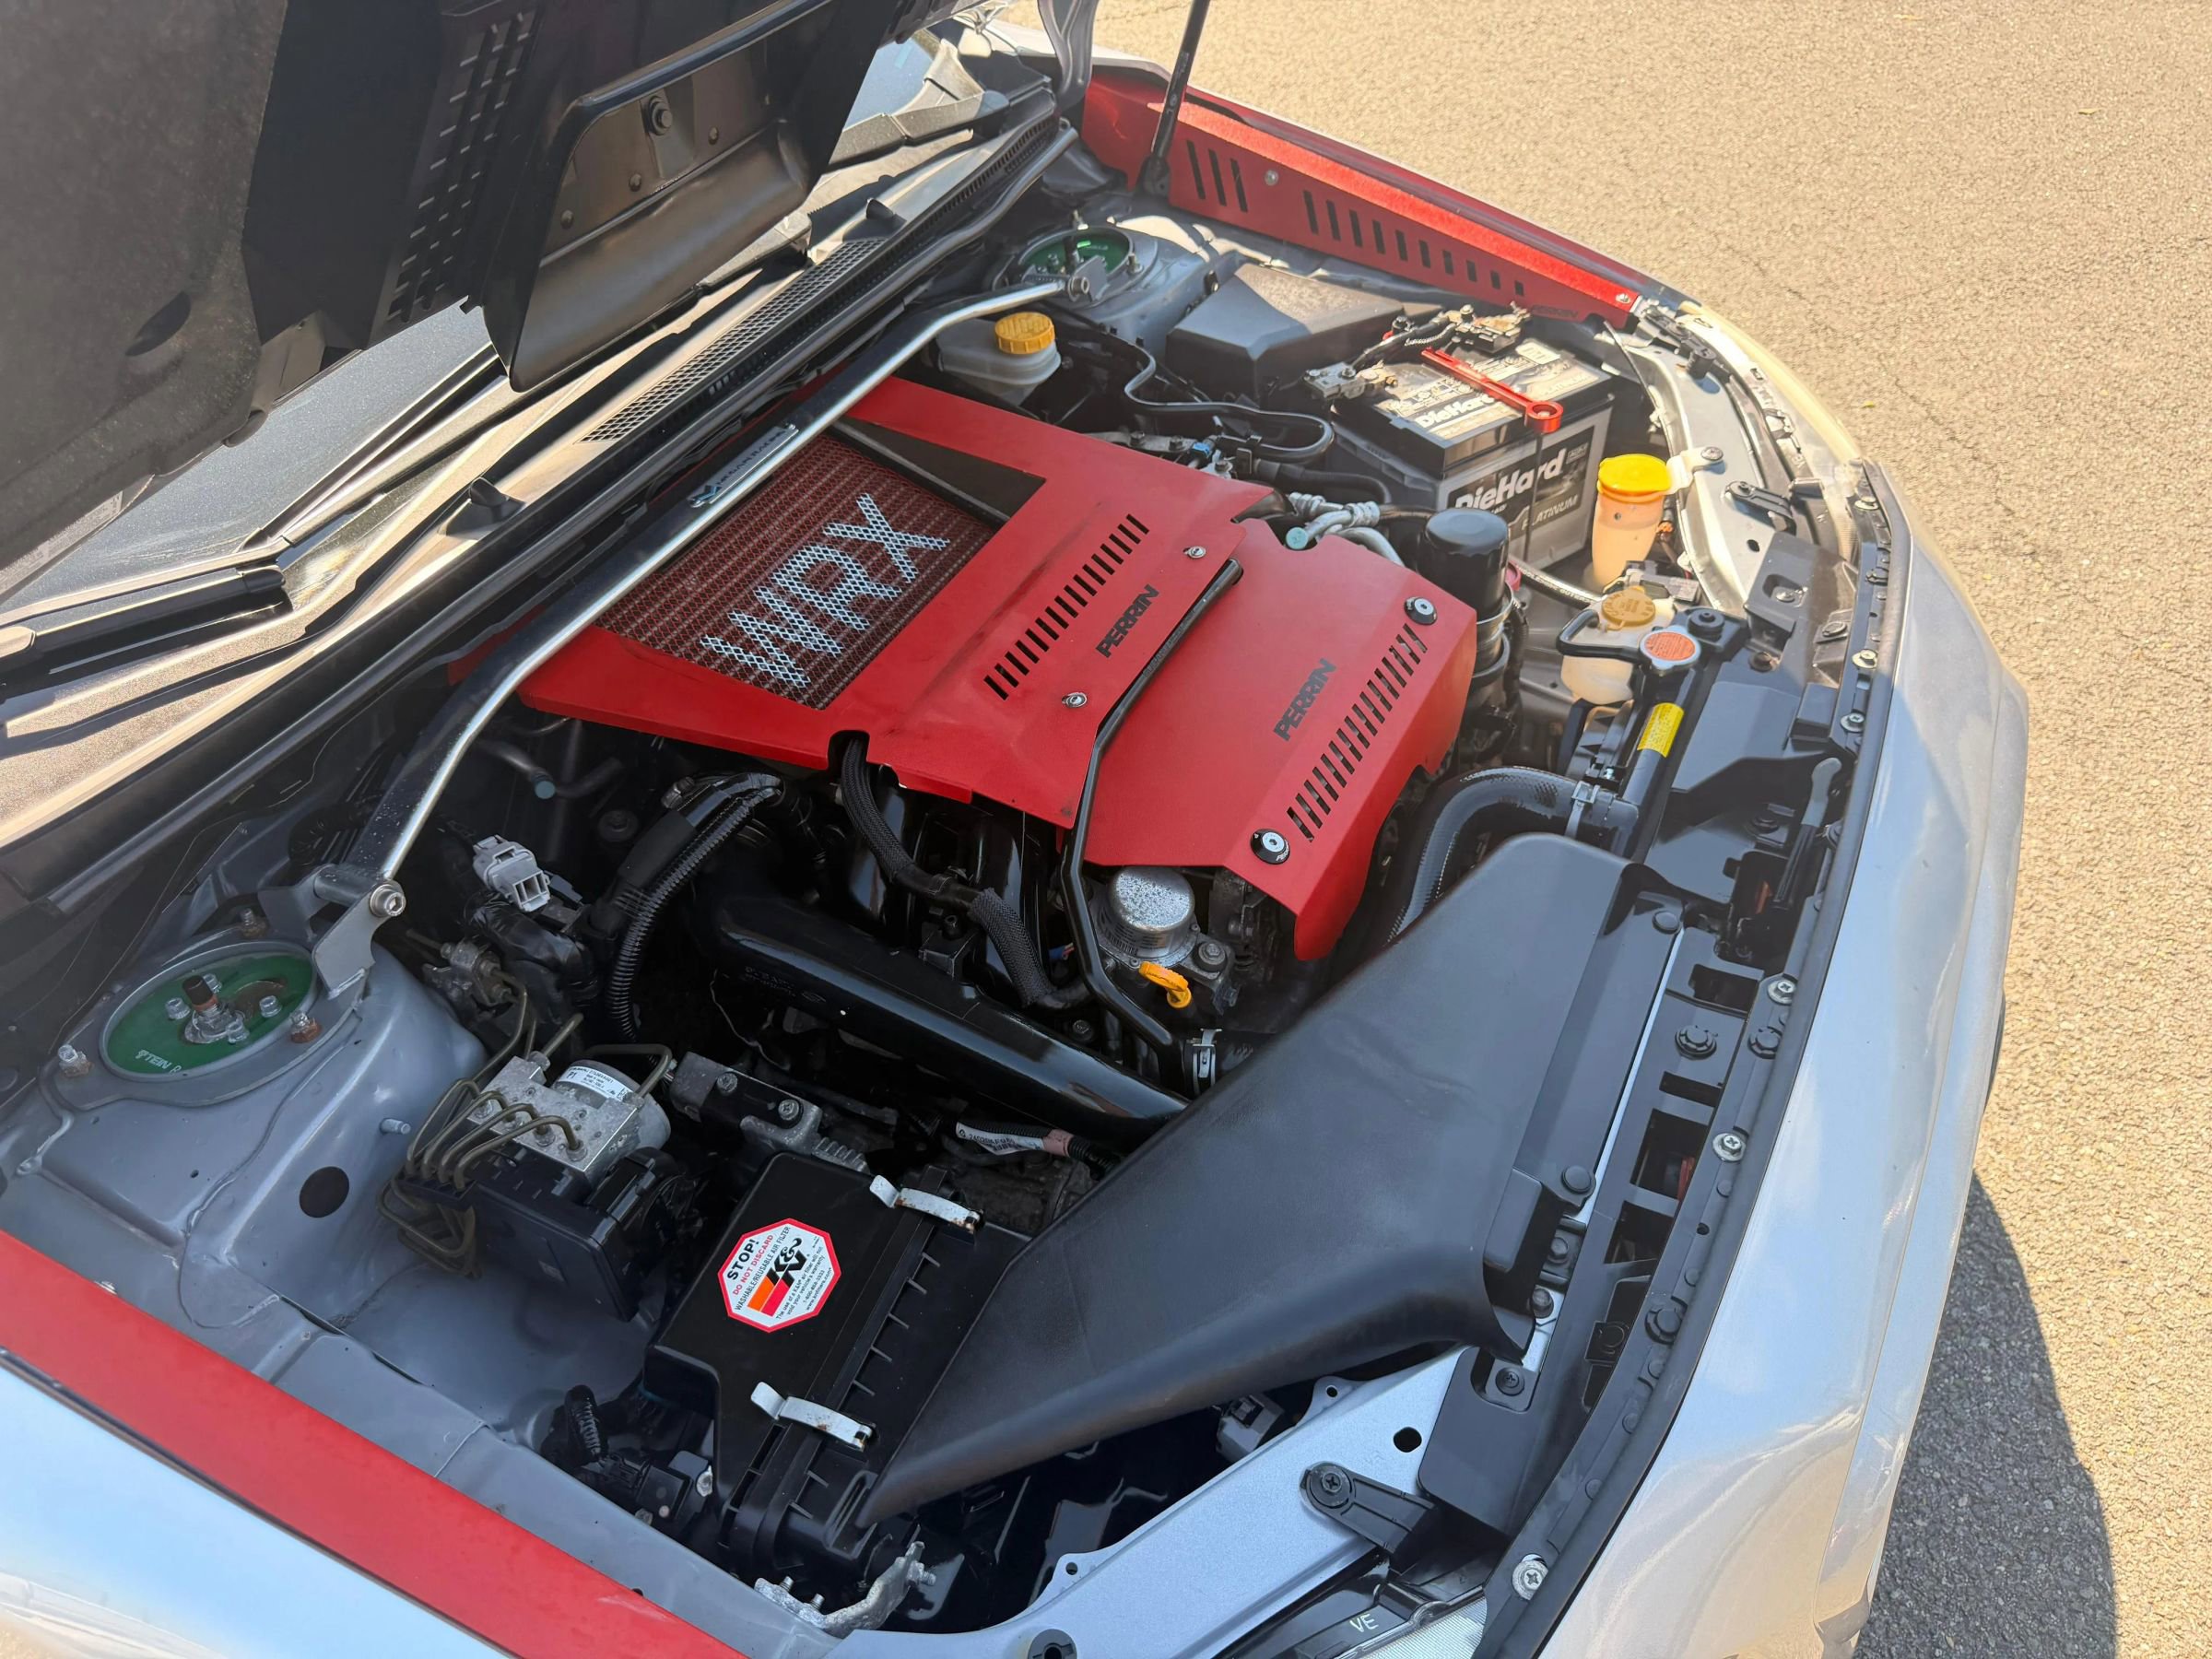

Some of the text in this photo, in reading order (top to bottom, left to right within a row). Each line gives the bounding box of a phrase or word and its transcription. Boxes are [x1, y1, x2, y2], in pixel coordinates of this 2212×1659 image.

[700, 493, 950, 688] WRX
[1095, 583, 1159, 658] PERRIN
[1273, 657, 1336, 741] PERRIN
[725, 1238, 759, 1280] STOP!
[733, 1233, 773, 1295] DO NOT DISCARD
[734, 1226, 791, 1311] WASHABLE/REUSABLE AIR FILTER
